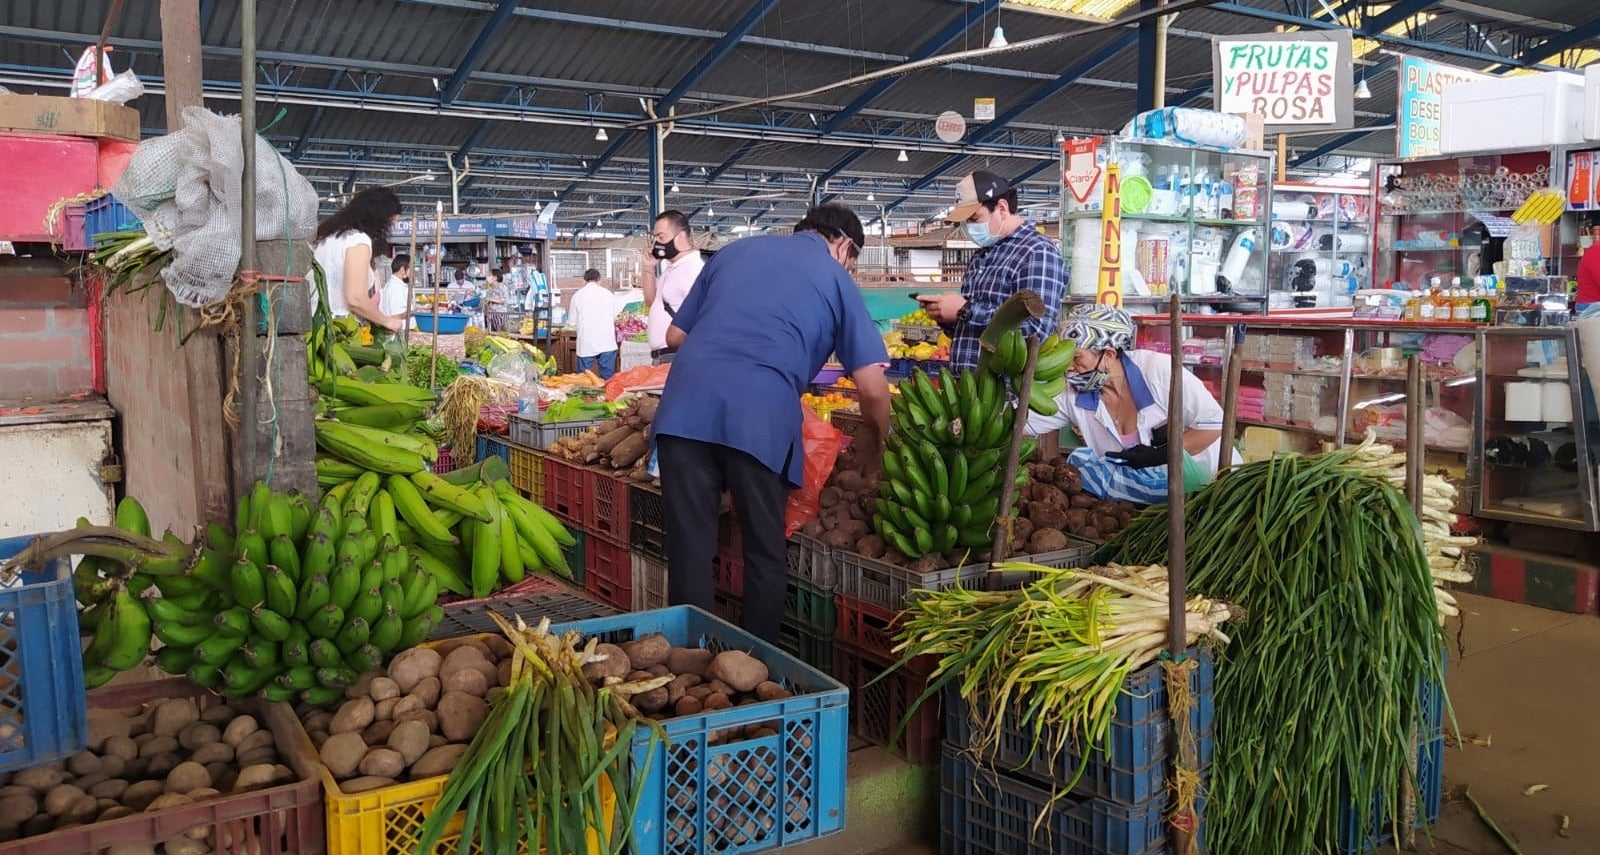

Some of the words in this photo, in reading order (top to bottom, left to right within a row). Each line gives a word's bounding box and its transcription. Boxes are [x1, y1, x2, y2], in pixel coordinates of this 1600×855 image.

[1229, 43, 1329, 70] FRUTAS
[1235, 71, 1332, 96] PULPAS
[1251, 96, 1324, 120] ROSA
